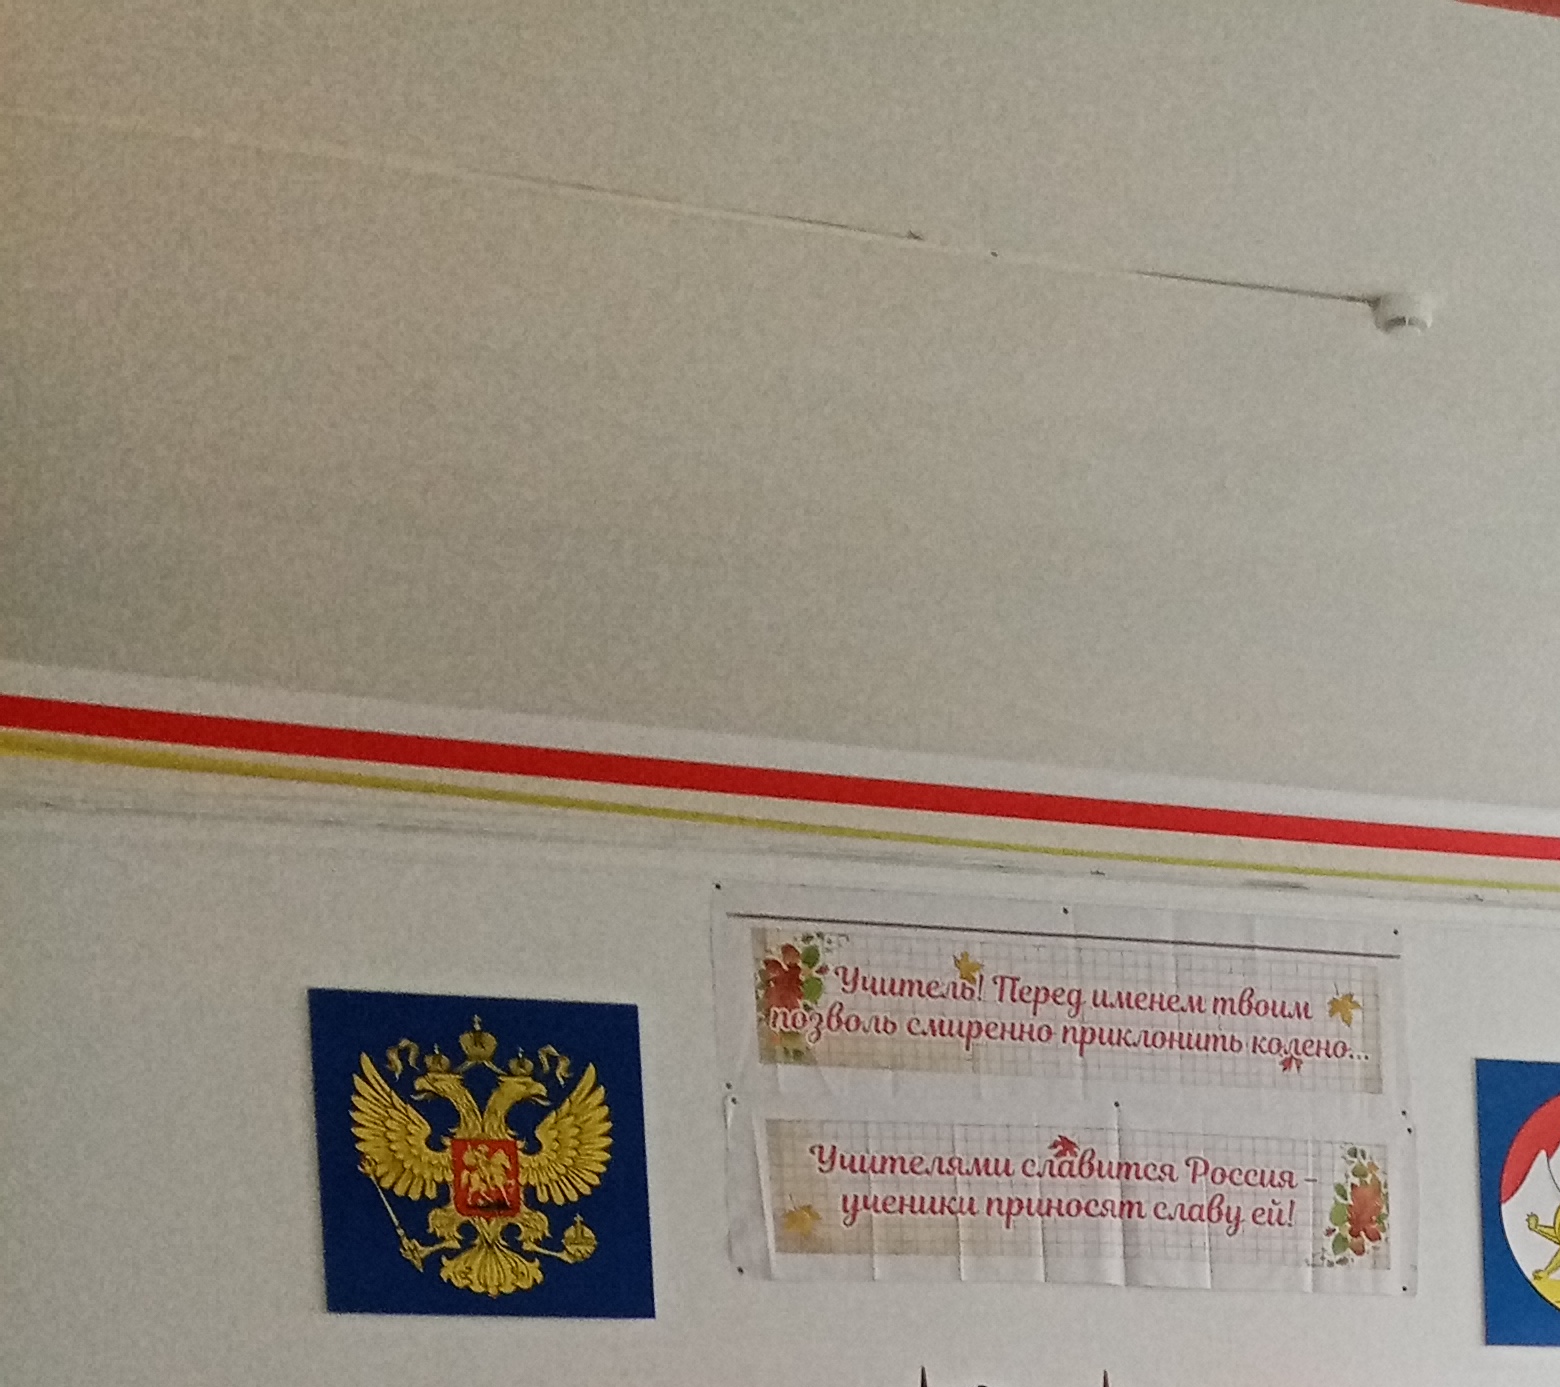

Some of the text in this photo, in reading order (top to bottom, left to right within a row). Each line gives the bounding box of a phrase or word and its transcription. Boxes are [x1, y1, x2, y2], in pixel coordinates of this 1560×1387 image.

[834, 964, 1314, 1020] Учитель! Перед именем твоим
[770, 1001, 1370, 1061] позволь смиренно приклонить колено...
[809, 1143, 1015, 1178] Учителями
[1021, 1148, 1179, 1183] славится
[1185, 1155, 1299, 1189] Россия
[841, 1193, 1297, 1237] ученики приносят славу ей!
